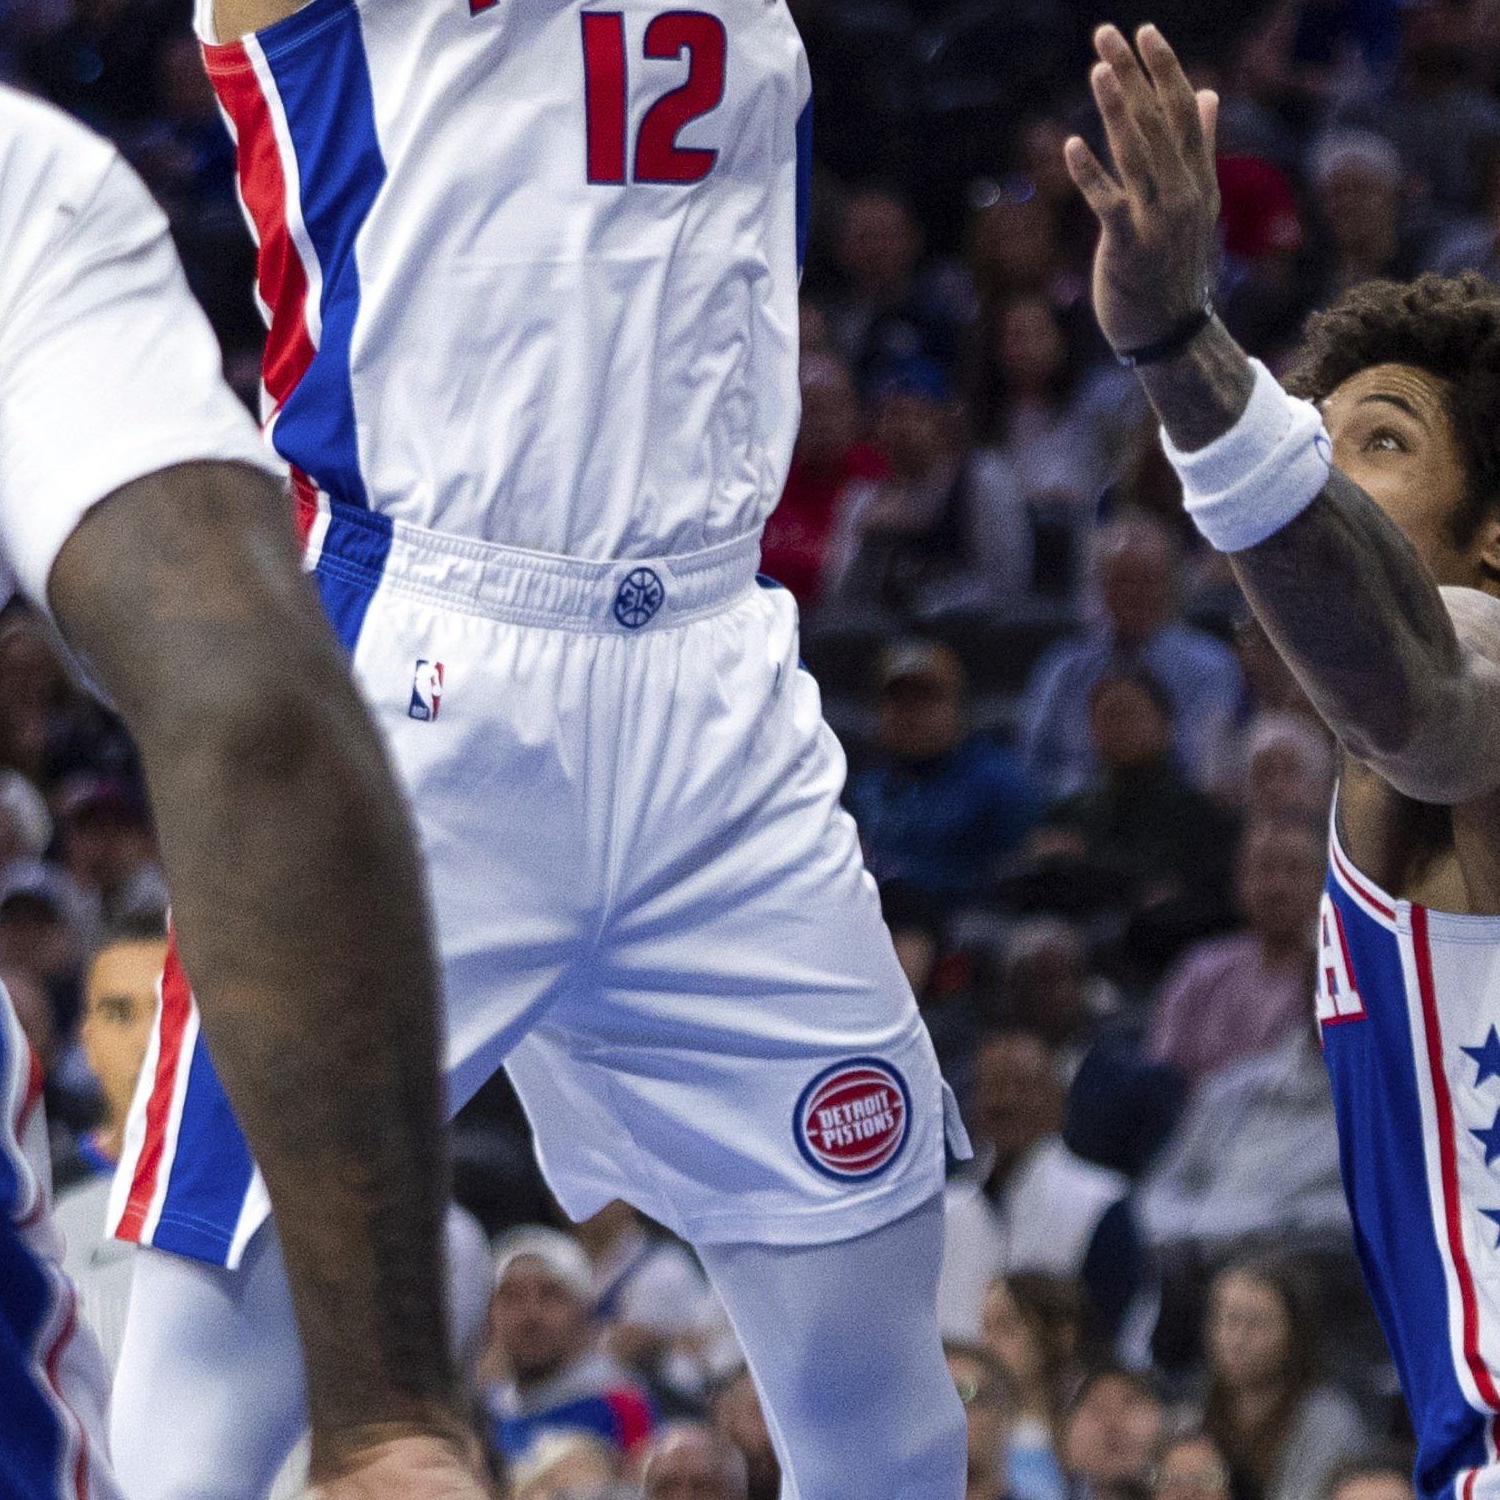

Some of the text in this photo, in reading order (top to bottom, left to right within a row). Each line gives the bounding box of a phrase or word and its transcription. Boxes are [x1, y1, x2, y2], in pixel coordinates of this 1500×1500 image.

[579, 8, 728, 186] 12
[818, 1089, 890, 1130] DETROIT
[820, 1108, 895, 1151] PISTONS
